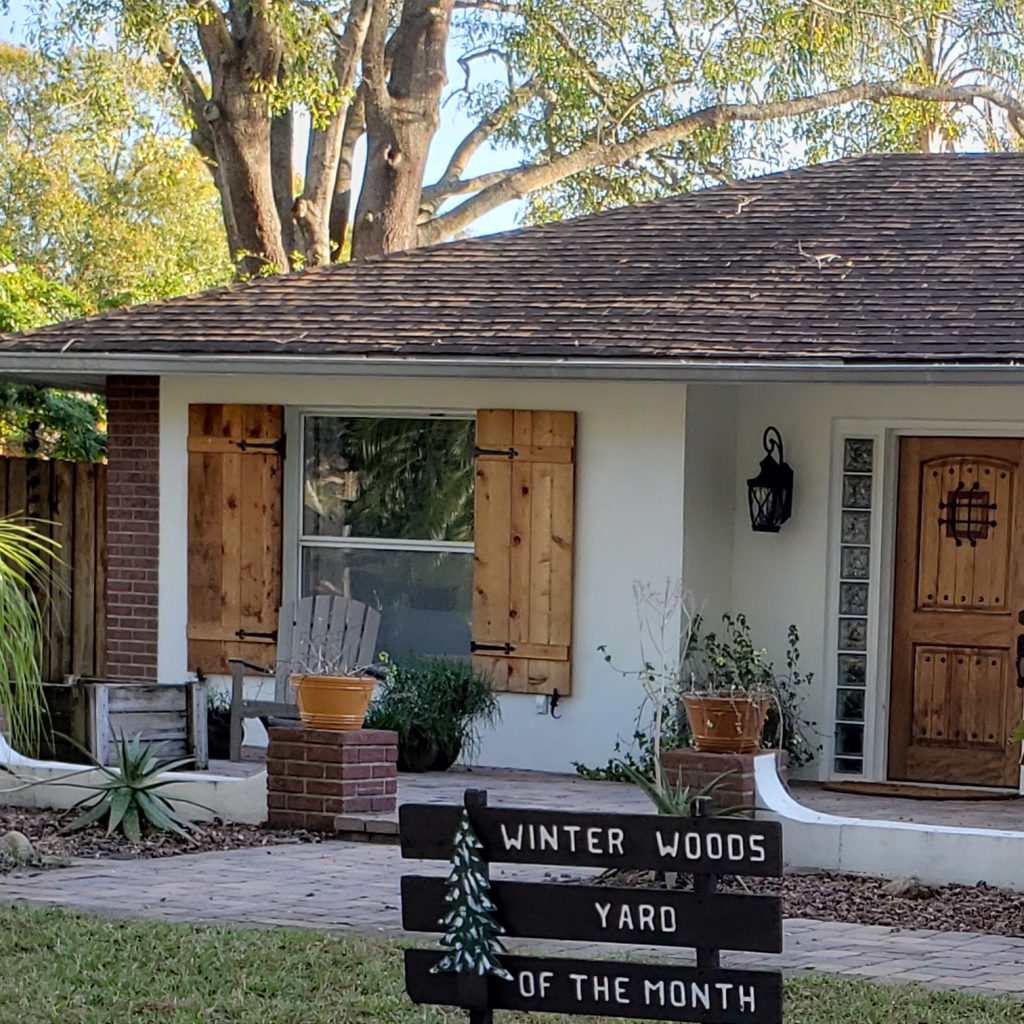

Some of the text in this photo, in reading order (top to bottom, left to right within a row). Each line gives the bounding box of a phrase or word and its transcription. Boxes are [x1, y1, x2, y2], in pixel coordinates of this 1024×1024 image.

[500, 824, 766, 862] WINTER WOODS
[594, 902, 677, 932] YARD
[518, 970, 756, 1013] OF THE MONTH
